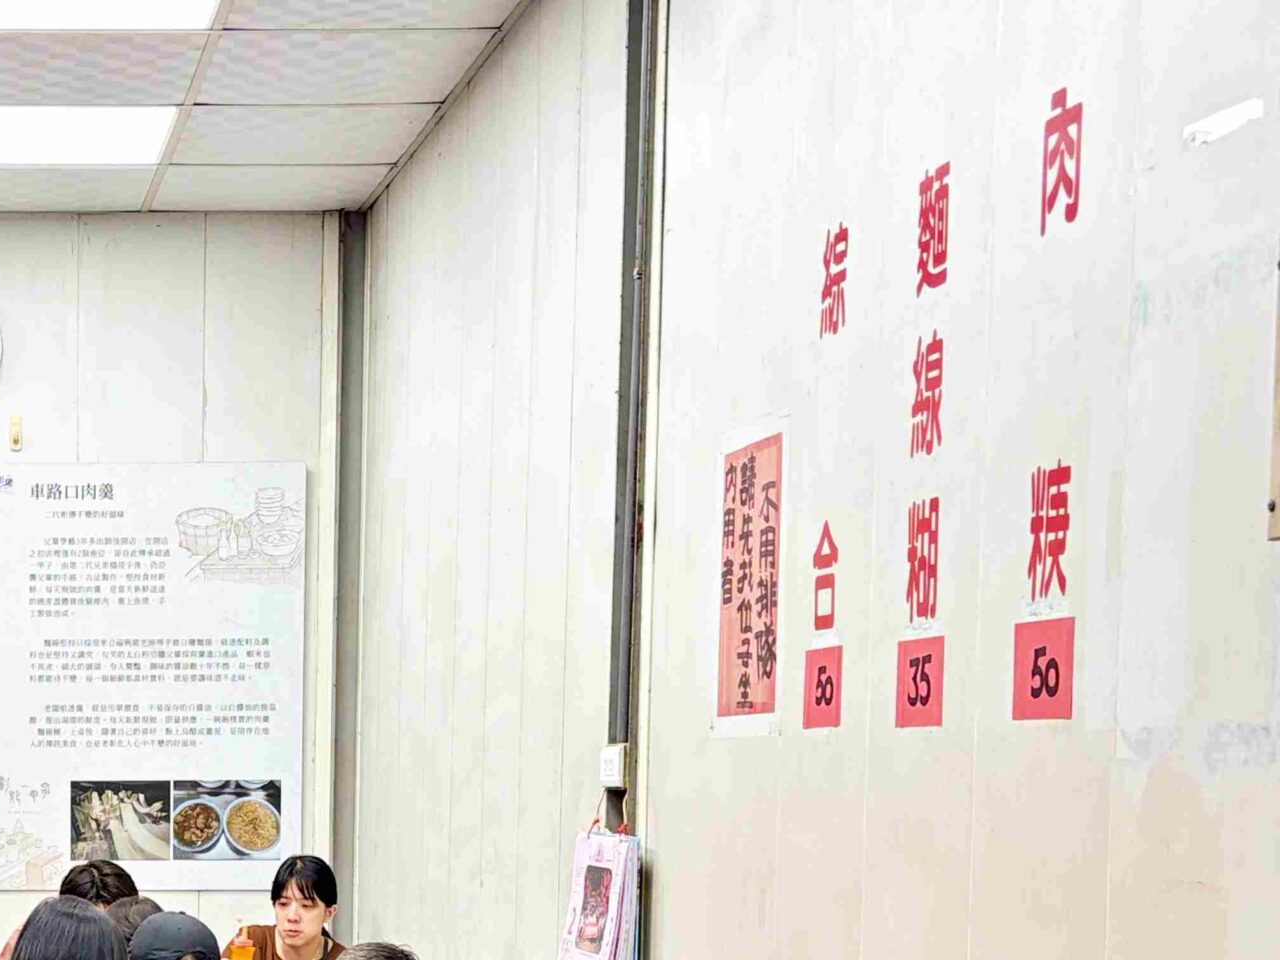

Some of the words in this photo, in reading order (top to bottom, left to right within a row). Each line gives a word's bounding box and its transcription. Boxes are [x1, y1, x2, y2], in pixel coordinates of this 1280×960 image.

[906, 160, 950, 624] 麵線糊
[30, 482, 114, 501] 車路口肉羹
[815, 666, 834, 706] 50
[908, 654, 932, 707] 35
[1032, 646, 1060, 699] 50
